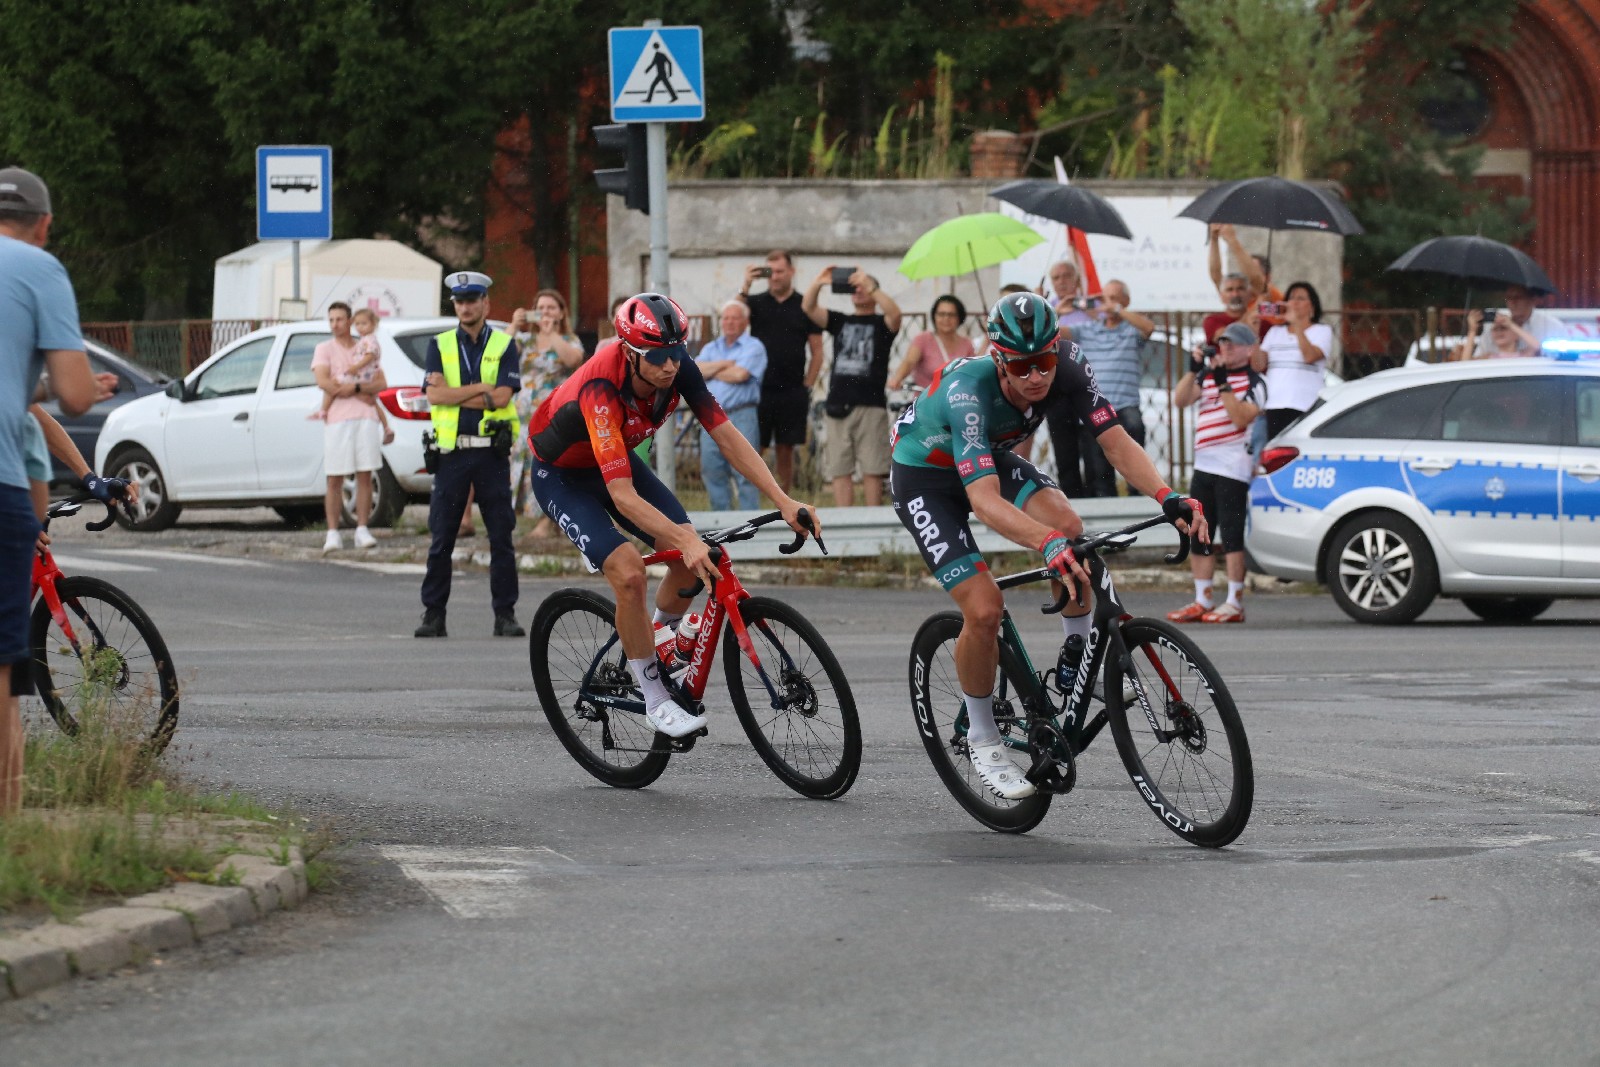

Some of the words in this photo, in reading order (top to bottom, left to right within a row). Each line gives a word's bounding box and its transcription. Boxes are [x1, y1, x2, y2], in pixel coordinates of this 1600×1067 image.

[948, 393, 979, 404] BORA
[594, 405, 616, 452] INEOS
[1293, 467, 1336, 488] B818
[547, 500, 590, 552] INEOS
[907, 496, 949, 565] BORA
[943, 565, 969, 582] COL
